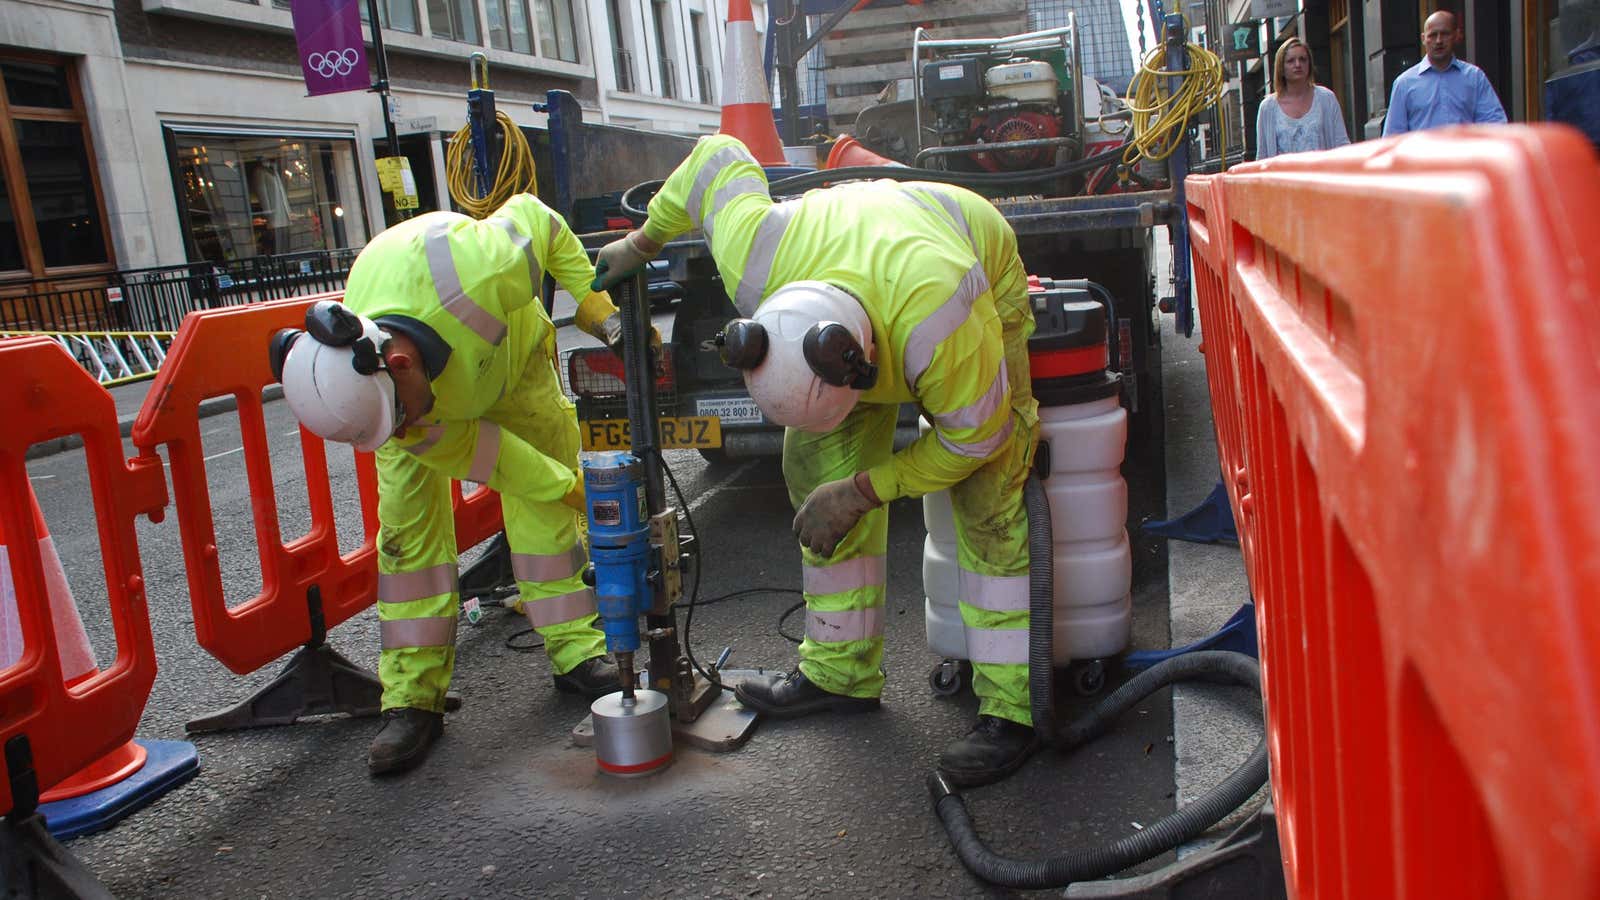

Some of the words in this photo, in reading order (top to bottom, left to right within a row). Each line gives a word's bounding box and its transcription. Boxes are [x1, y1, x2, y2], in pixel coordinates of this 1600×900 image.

[396, 198, 409, 208] NO
[732, 407, 748, 417] 800
[590, 420, 632, 447] FG5
[660, 420, 711, 445] RJZ
